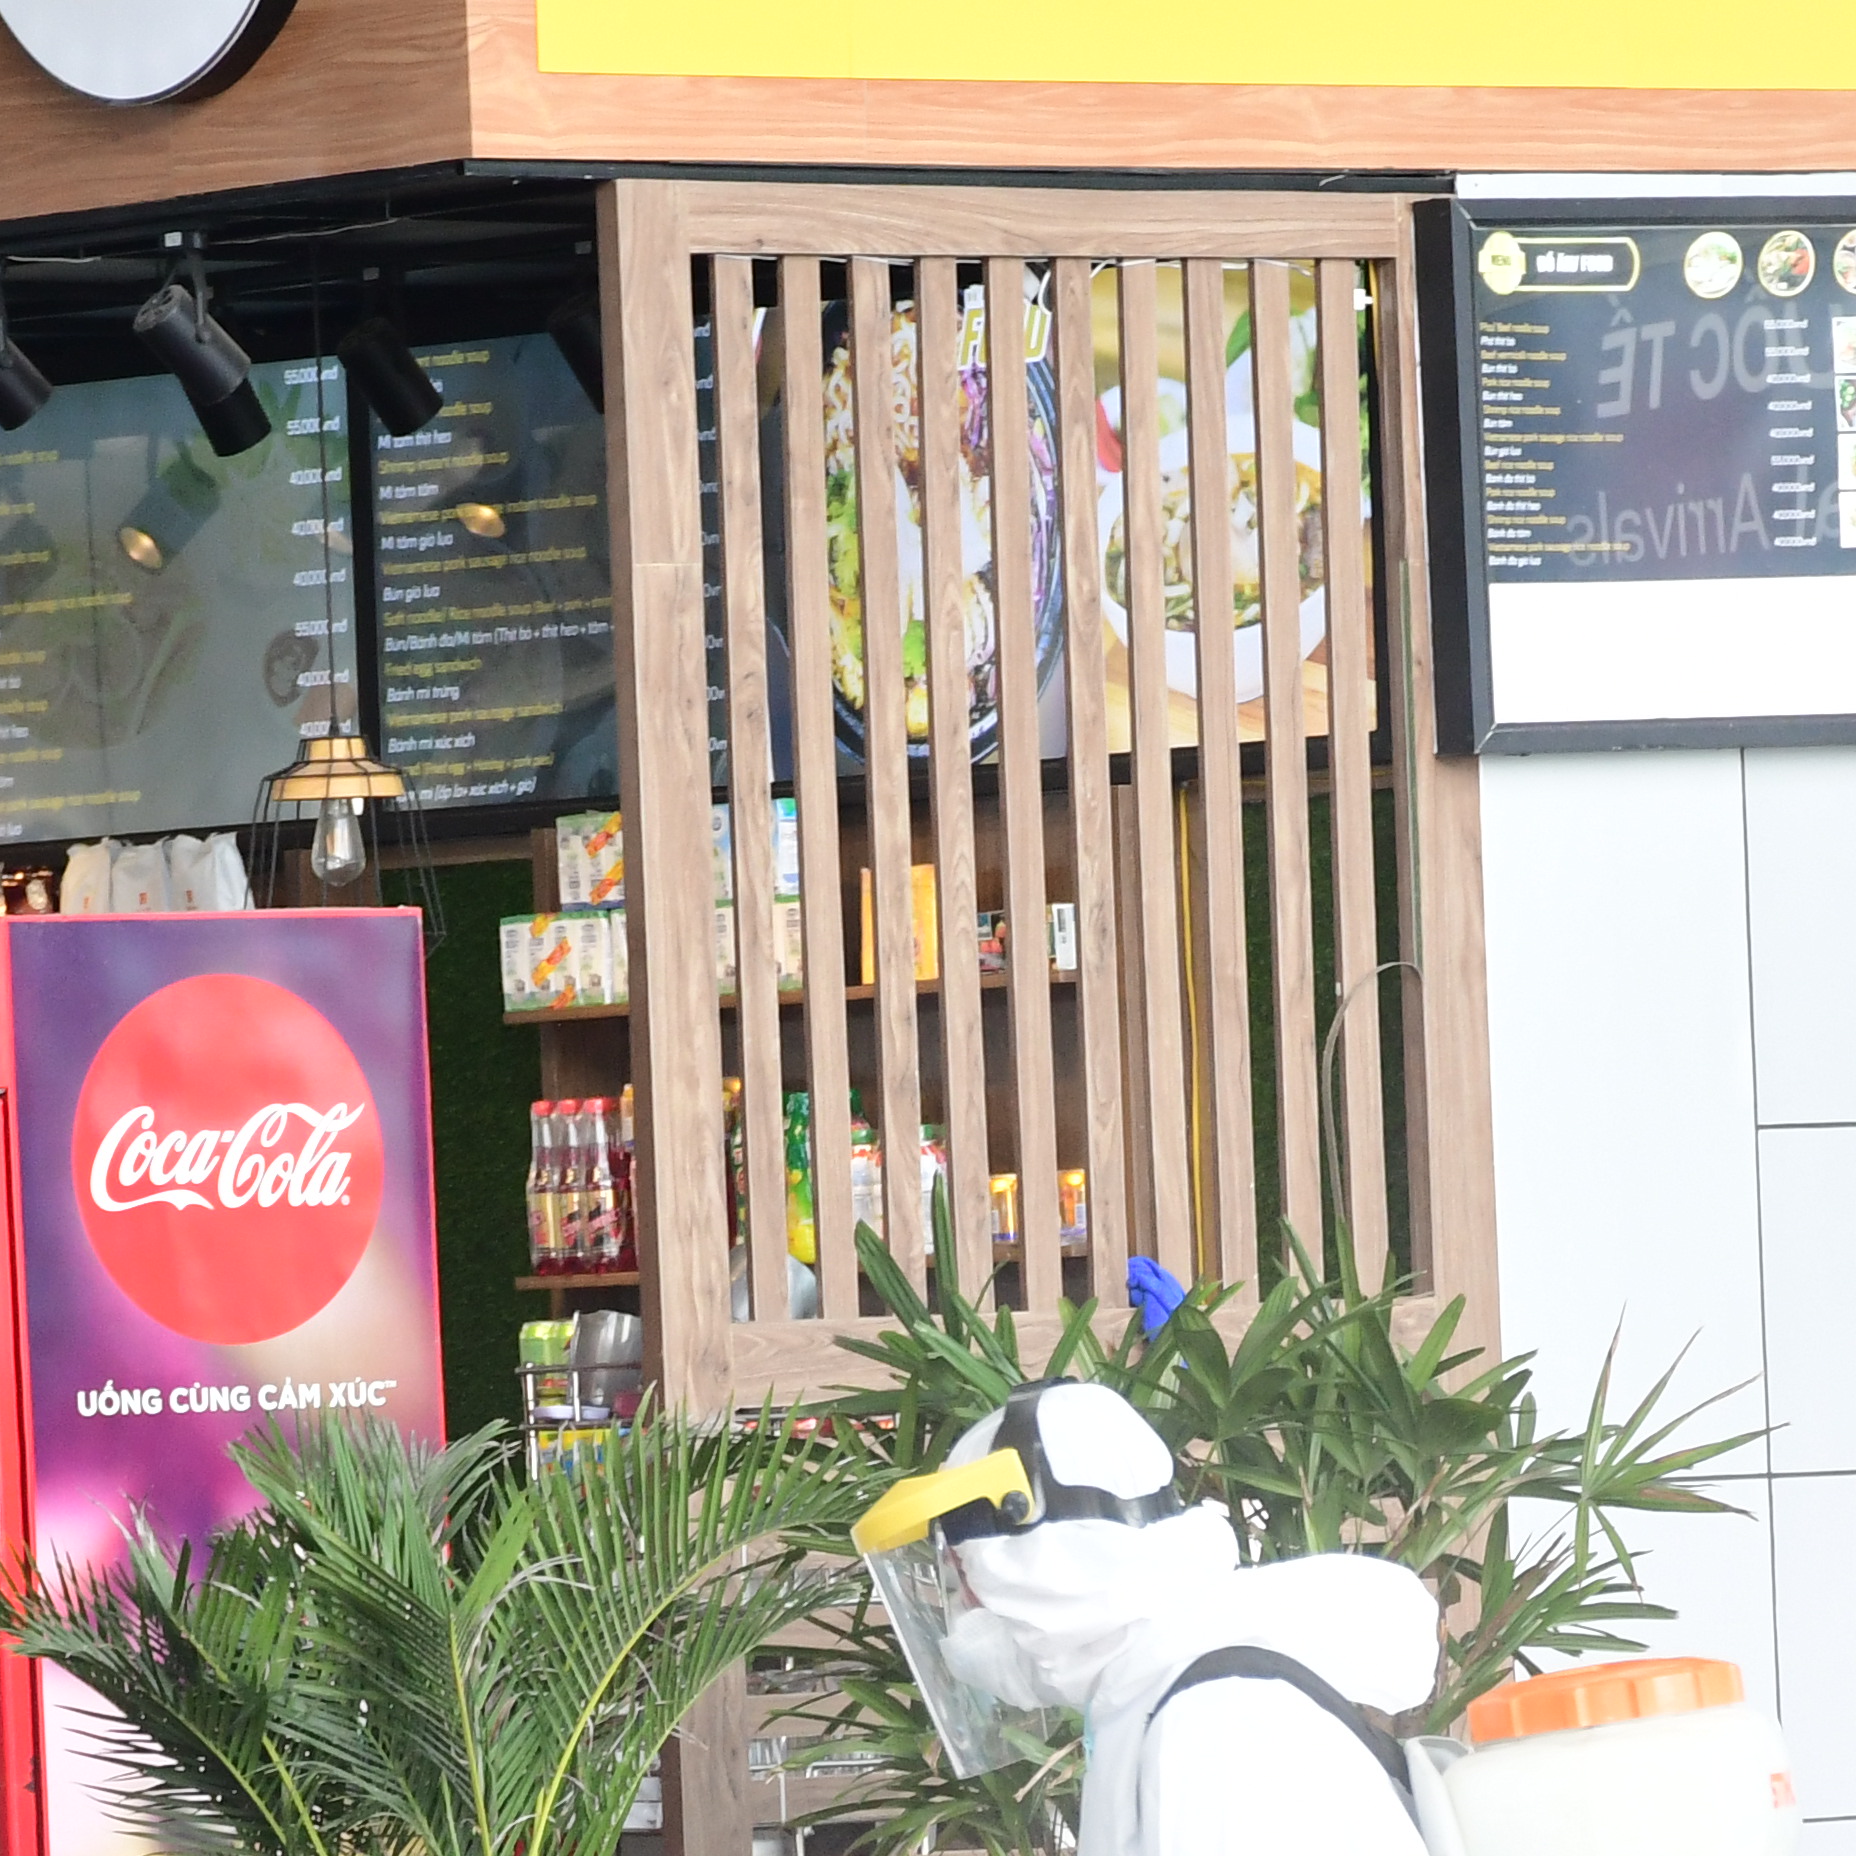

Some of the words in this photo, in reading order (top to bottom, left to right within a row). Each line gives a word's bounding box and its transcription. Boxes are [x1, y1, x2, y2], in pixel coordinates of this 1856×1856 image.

[90, 1100, 366, 1212] Coca-Cola
[77, 1379, 164, 1418] UỐNG
[169, 1382, 252, 1414] CÙNG
[257, 1376, 322, 1411] CẢM
